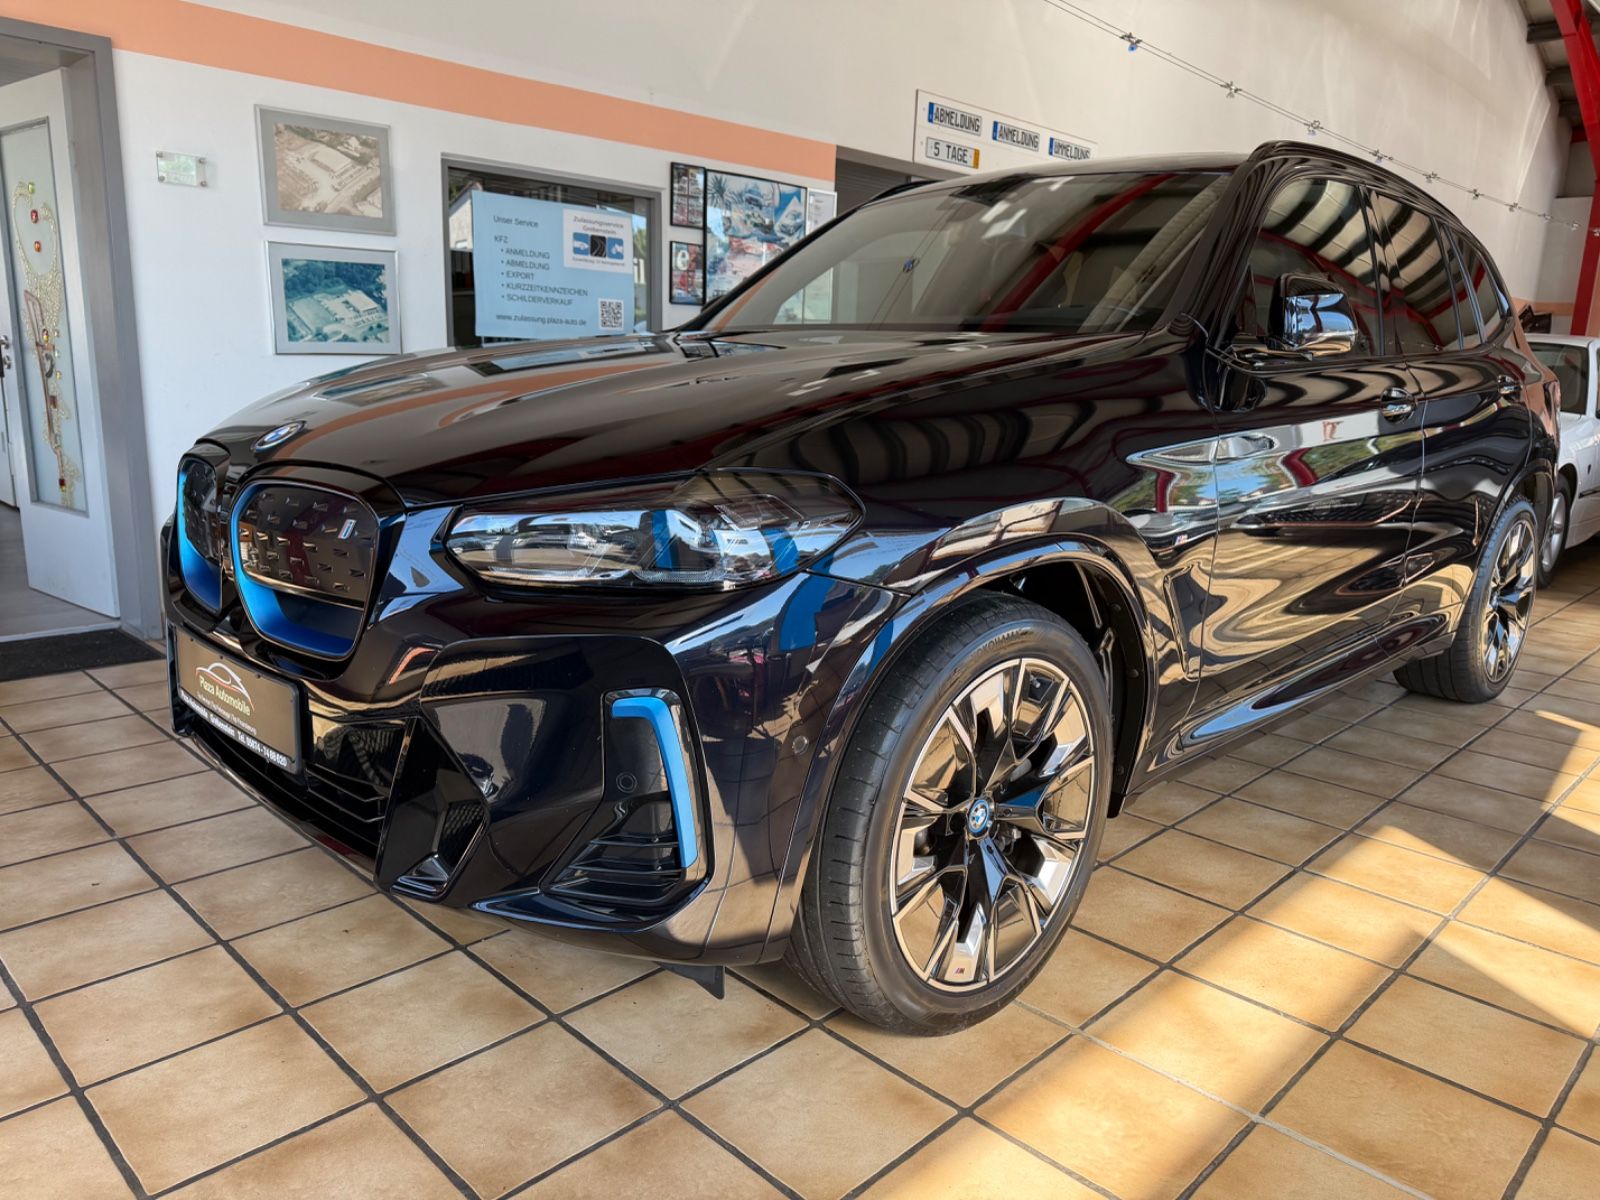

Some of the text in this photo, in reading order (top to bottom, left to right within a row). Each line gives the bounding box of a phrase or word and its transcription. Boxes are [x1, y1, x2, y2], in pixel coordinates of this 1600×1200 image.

[934, 106, 980, 132] ABMELDUNG
[998, 125, 1039, 149] ANMELDUNG
[933, 142, 968, 164] 5 TAGE
[493, 215, 539, 229] Unser Service
[494, 235, 508, 243] KFZ
[505, 248, 550, 260] ANMELDUNG
[505, 259, 550, 271] ABMELDUNG
[506, 271, 535, 281] EXPORT
[506, 282, 589, 297] KURZZEITKENNZEICHEN
[506, 294, 574, 306] SCHILDERVERKAUF
[216, 685, 251, 716] Automobile
